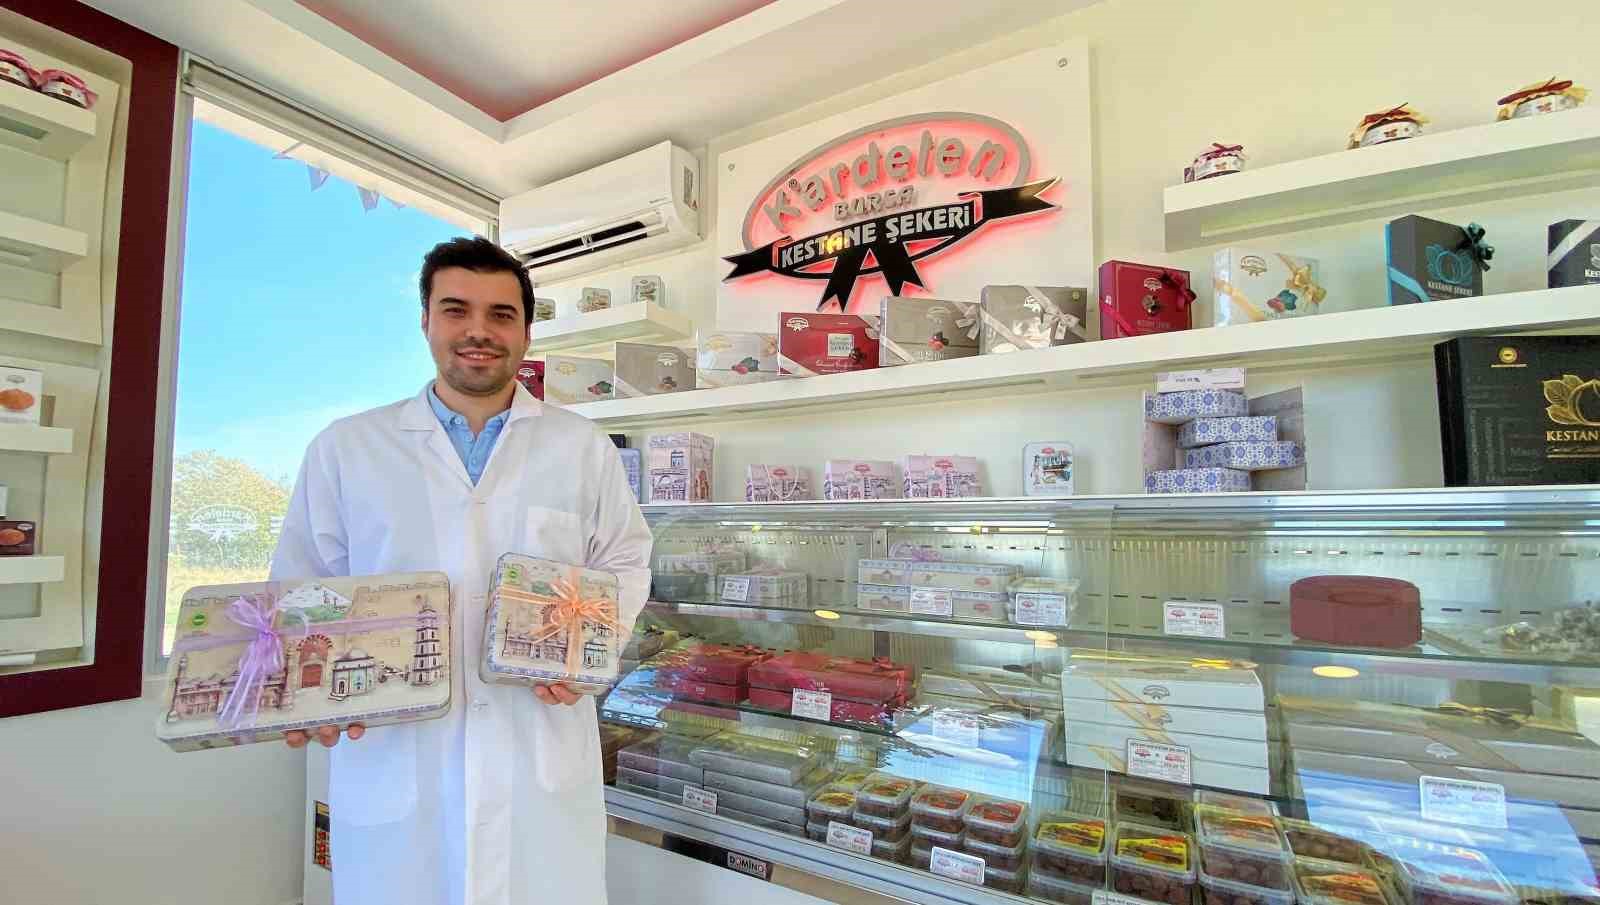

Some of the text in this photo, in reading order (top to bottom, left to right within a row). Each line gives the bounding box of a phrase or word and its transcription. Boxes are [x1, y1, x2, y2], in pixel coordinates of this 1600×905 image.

[763, 130, 1007, 229] Kardelen
[834, 186, 915, 220] BURSA
[781, 222, 878, 268] KESTANE
